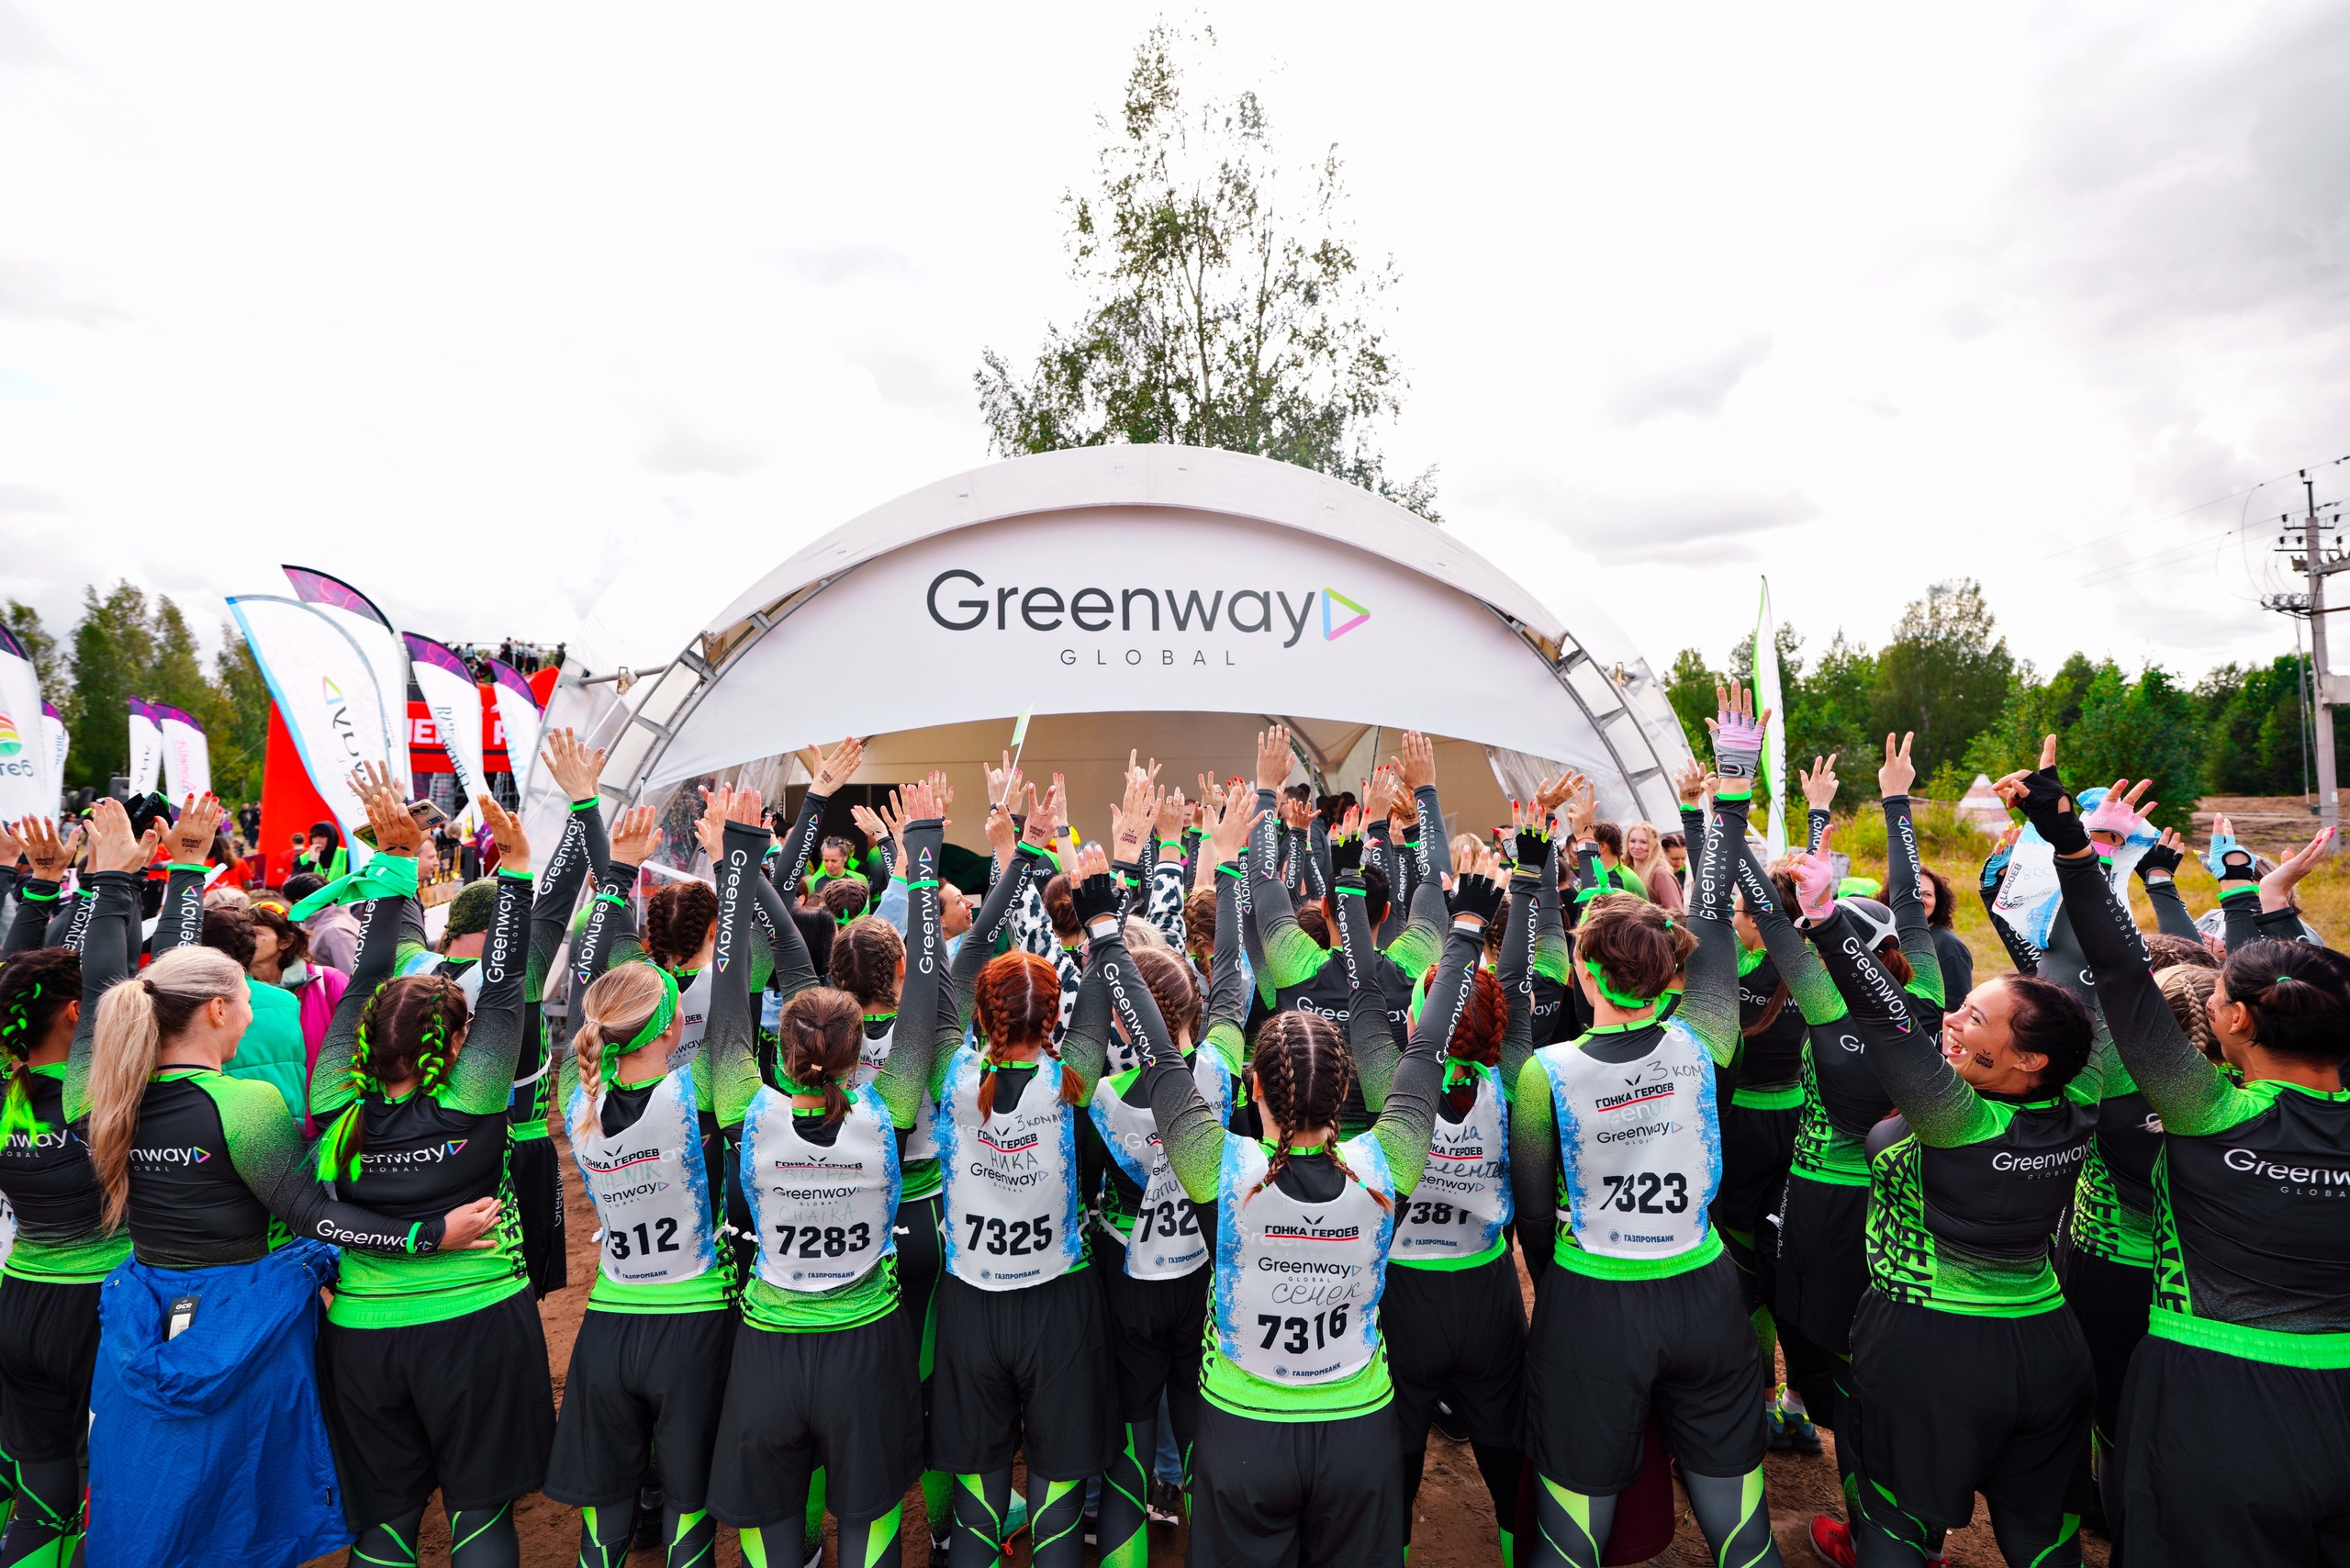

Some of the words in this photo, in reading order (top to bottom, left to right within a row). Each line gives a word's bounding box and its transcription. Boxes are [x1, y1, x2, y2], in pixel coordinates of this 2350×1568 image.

[926, 568, 1315, 648] Greenway
[1060, 649, 1236, 666] GLOBAL
[783, 822, 818, 891] Greenway
[1418, 810, 1430, 876] Greenway
[1286, 834, 1298, 889] Greenway
[1700, 827, 1724, 920] Greenway
[1901, 825, 1923, 900] Greenway
[1738, 857, 1770, 909] enway
[718, 849, 747, 958] Greenway
[62, 899, 90, 950] enway
[487, 889, 516, 983] Greenway
[510, 910, 520, 953] GLOBAL
[2106, 898, 2136, 947] GLOBAL
[1337, 894, 1359, 984] Greenway
[1519, 908, 1539, 993] Greenway
[1842, 936, 1910, 1021] Greenway
[1851, 972, 1881, 1010] GLOBAL
[1104, 963, 1154, 1058] Greenway
[1296, 996, 1408, 1025] Greeay
[1436, 970, 1472, 1063] Greenway
[1647, 1060, 1668, 1081] 3
[1975, 1052, 1994, 1064] ГОНКА
[1595, 1090, 1632, 1109] ГОНКА
[1634, 1082, 1674, 1100] ГЕРОЕВ
[1014, 1114, 1025, 1132] 3
[1596, 1122, 1670, 1144] Greenway
[5, 1129, 68, 1148] nway
[978, 1129, 999, 1148] ГОНКА
[1001, 1132, 1037, 1149] ГЕРОЕВ
[1449, 1147, 1483, 1157] ГЕРОЕВ
[129, 1148, 193, 1166] nway
[360, 1144, 445, 1164] enway
[582, 1154, 610, 1170] ГОНКА
[615, 1148, 659, 1167] ГЕРОЕВ
[990, 1148, 1038, 1172] НИКА
[1992, 1142, 2088, 1171] Greenway
[2223, 1148, 2350, 1185] Greenw
[970, 1162, 1037, 1186] Greenway
[993, 1182, 1023, 1193] GLOBAL
[1420, 1173, 1476, 1193] eenway
[2027, 1168, 2072, 1180] GLOBAL
[603, 1182, 657, 1204] enway
[773, 1186, 856, 1199] Greenway
[1599, 1172, 1688, 1214] 7323
[2280, 1186, 2346, 1198] GLOBA
[1138, 1198, 1198, 1243] 732
[1265, 1226, 1307, 1236] ГОНКА
[1312, 1226, 1359, 1238] ГЕРОЕВ
[605, 1216, 679, 1260] 312
[776, 1222, 870, 1259] 7283
[966, 1213, 1052, 1256] 7325
[1624, 1234, 1674, 1243] ГАЗПРОМБАНК
[1168, 1248, 1205, 1264] ГАЗПРОМБАНК
[1259, 1257, 1351, 1279] Greenway
[622, 1270, 667, 1280] ГАЗПРОМБАНК
[808, 1271, 855, 1279] ГАЗПРОМБАНК
[995, 1269, 1040, 1280] ГАЗПРОМБАНК
[1258, 1303, 1350, 1354] 7316
[1292, 1362, 1341, 1377] ГАЗПРОМБАНК
